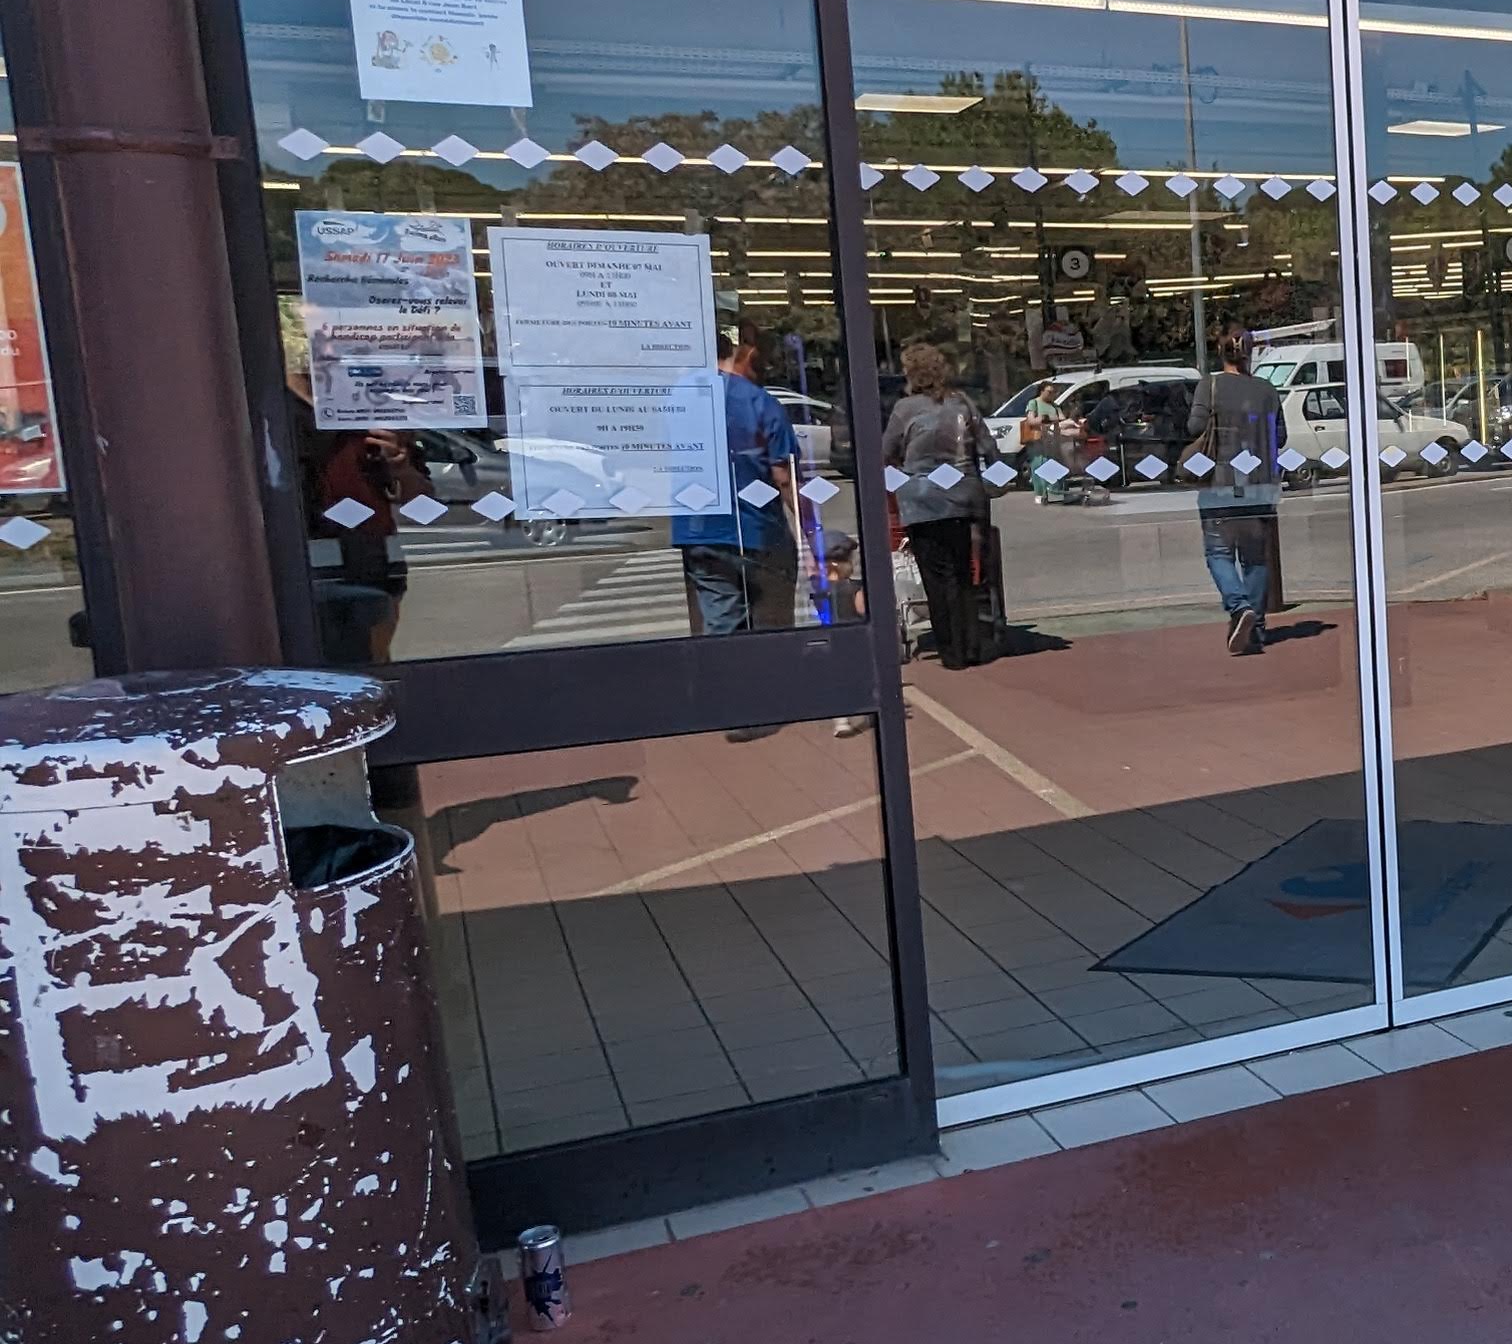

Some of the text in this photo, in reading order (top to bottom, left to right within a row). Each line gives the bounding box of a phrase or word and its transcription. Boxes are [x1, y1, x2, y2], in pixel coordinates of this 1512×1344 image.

[317, 226, 355, 236] USSAP
[375, 252, 390, 264] 17
[546, 260, 584, 269] OUVERT
[644, 263, 662, 271] MAI
[600, 281, 613, 289] ET
[576, 290, 605, 298] LUNDI
[619, 291, 637, 299] MAI
[618, 320, 660, 329] MINUTES
[663, 321, 693, 329] AVANT
[631, 443, 672, 451] MINUTES
[674, 443, 705, 451] AVANT
